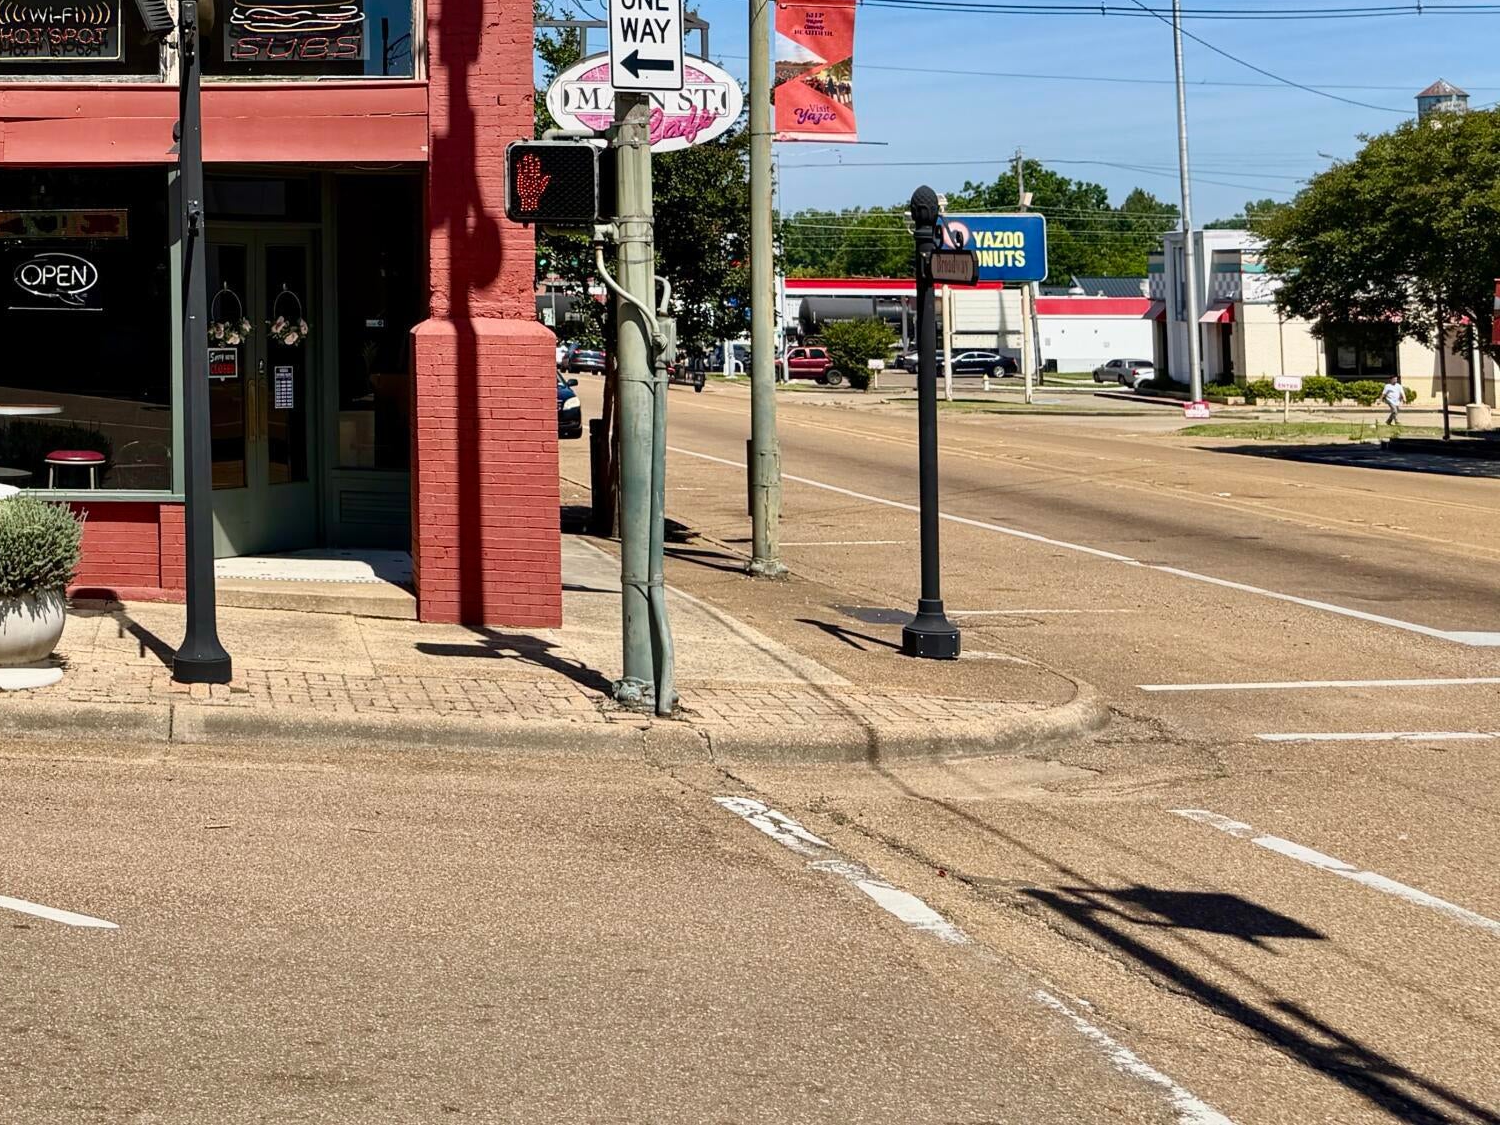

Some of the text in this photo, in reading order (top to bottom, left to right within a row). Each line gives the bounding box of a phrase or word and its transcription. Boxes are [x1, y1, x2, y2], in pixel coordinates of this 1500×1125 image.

[0, 28, 108, 44] HOT SPOT
[620, 17, 671, 44] WAY
[231, 36, 361, 57] SUBS
[575, 87, 665, 111] MN
[809, 103, 830, 112] Visit
[793, 107, 836, 125] Yazoo
[972, 231, 1025, 249] YAZOO
[21, 264, 88, 286] OPEN
[936, 254, 970, 279] Broadway
